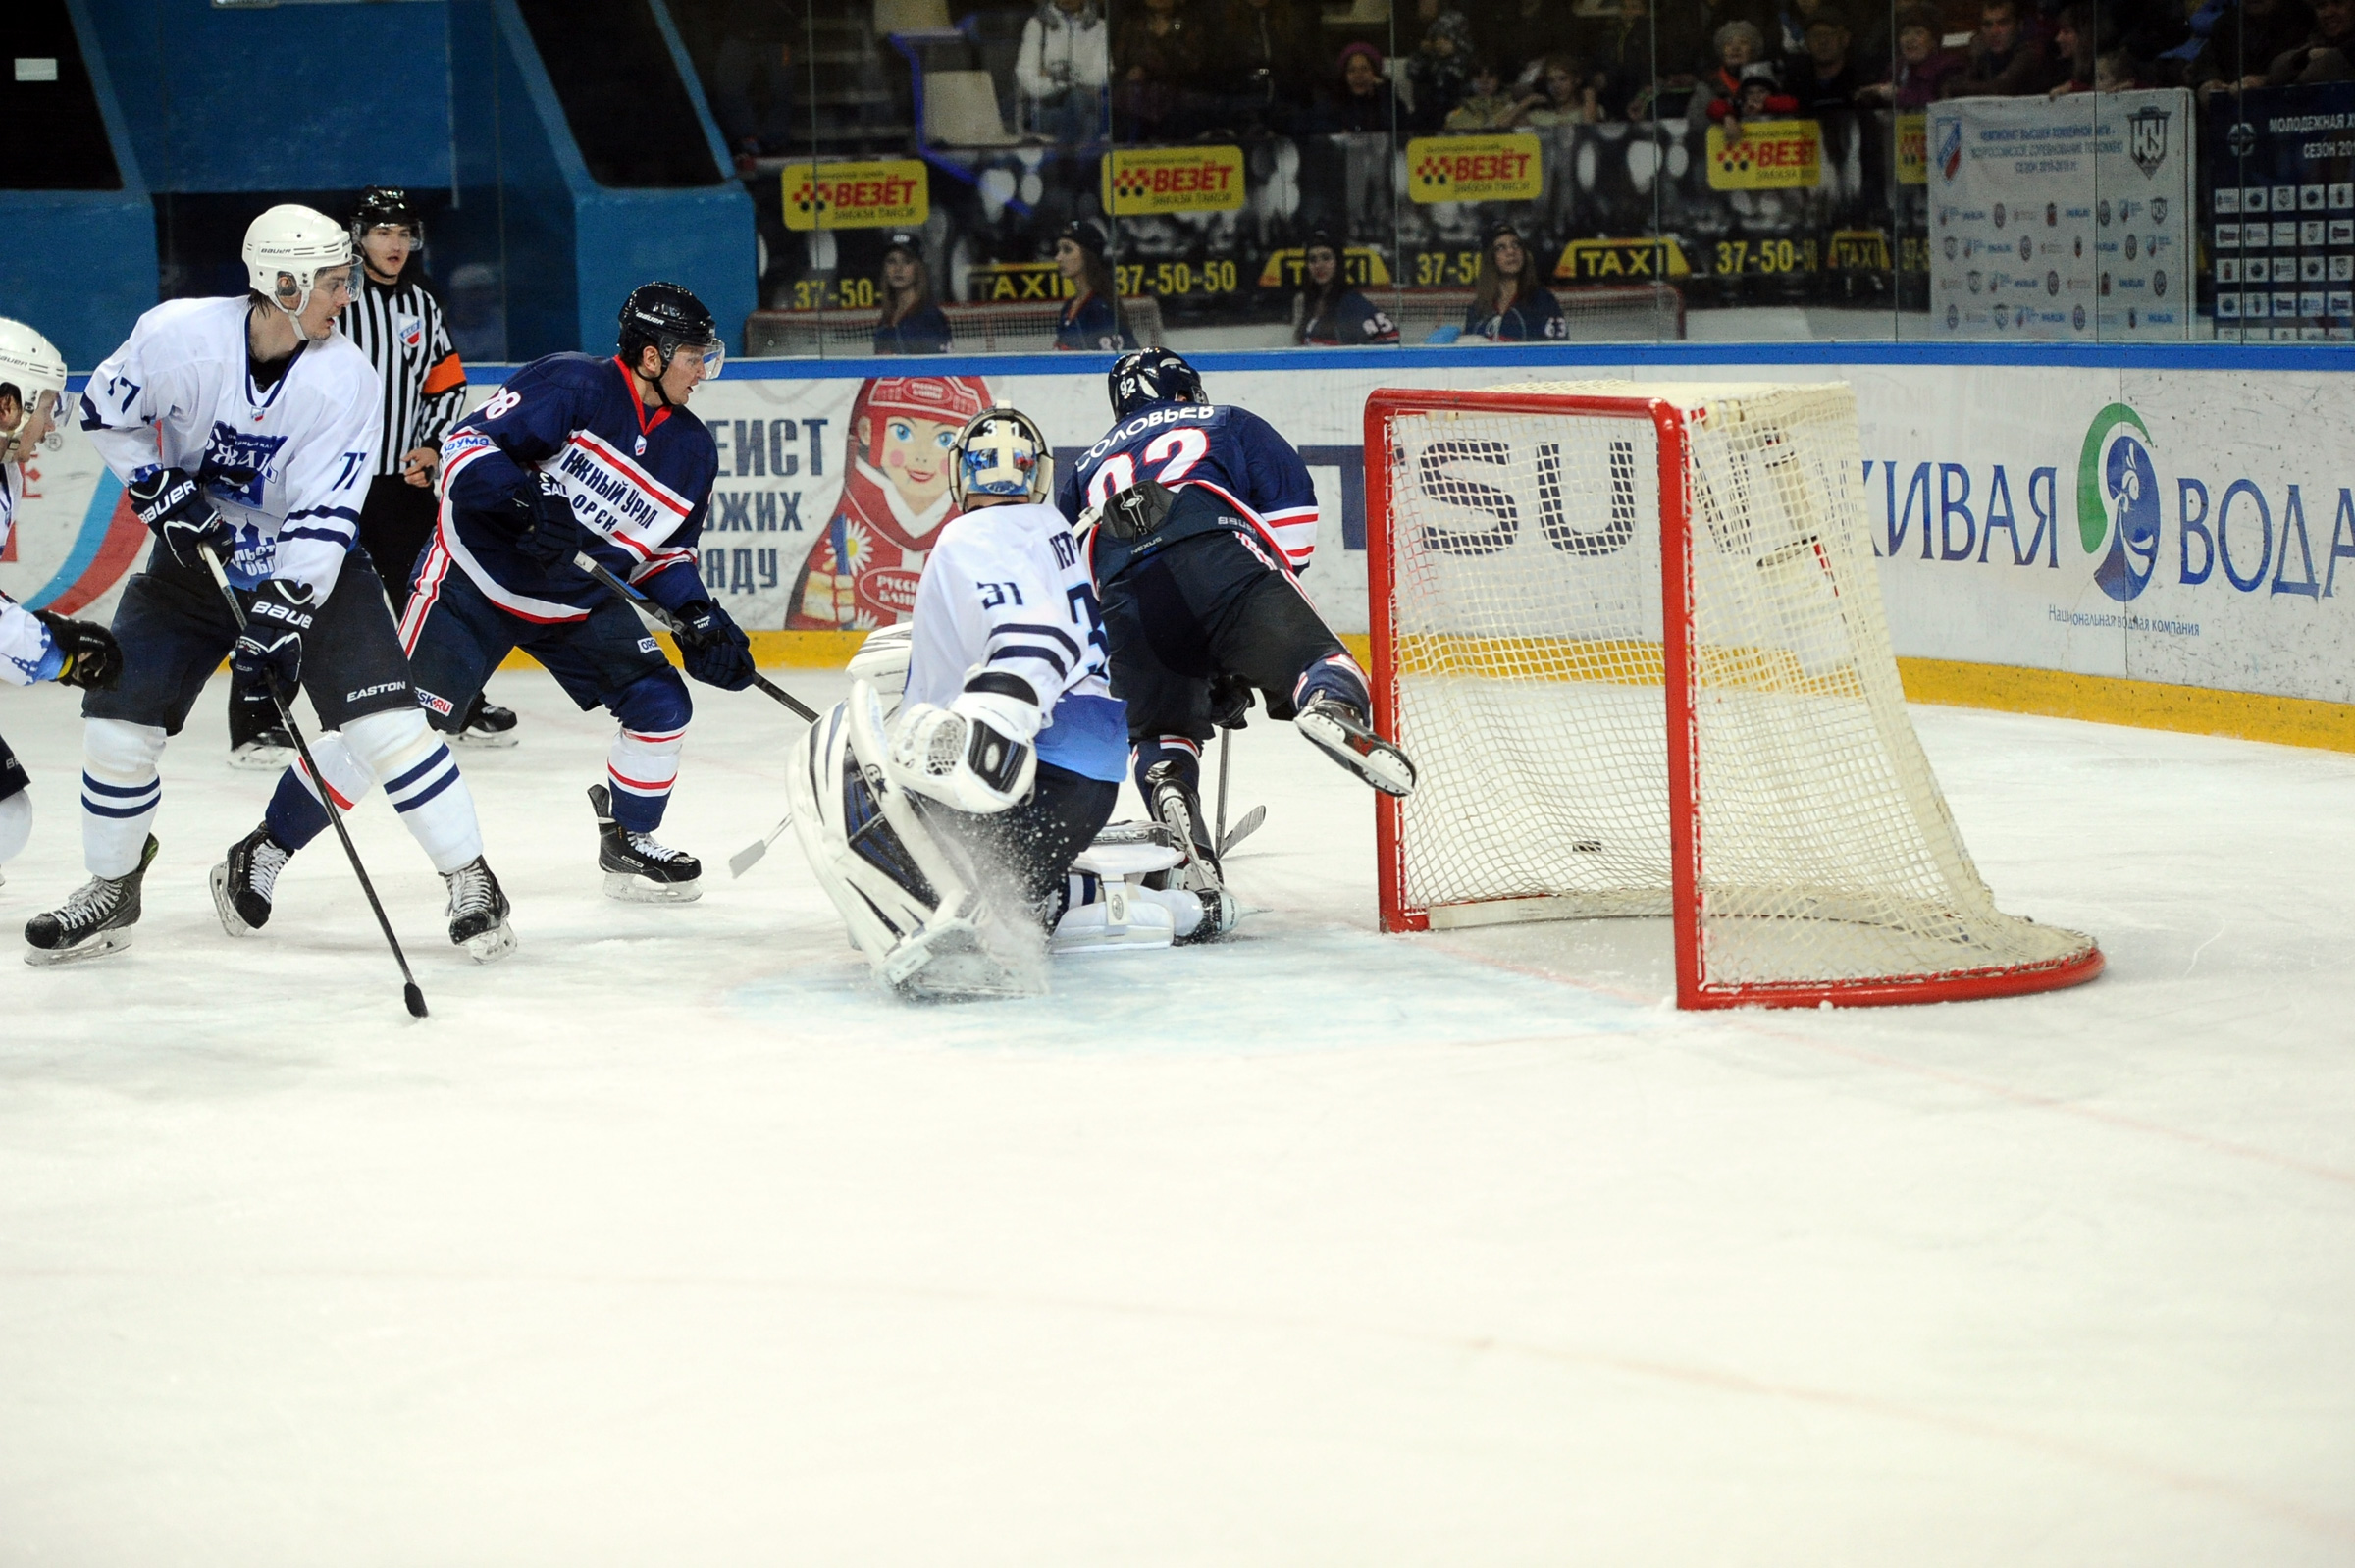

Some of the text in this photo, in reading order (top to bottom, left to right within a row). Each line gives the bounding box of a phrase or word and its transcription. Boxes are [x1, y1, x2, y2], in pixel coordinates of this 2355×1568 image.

[2269, 114, 2345, 133] МОЛОДЕЖНАЯ
[1455, 149, 1531, 181] ВЕЗЁТ
[2303, 143, 2336, 159] СЕЗОН
[835, 174, 917, 208] ВЕЗЁТ
[1154, 161, 1233, 192] ВЕЗЁТ
[1116, 260, 1237, 297] 37-50-50
[1286, 258, 1367, 285] TXI
[1580, 249, 1666, 277] TAXI
[0, 353, 28, 367] AUER
[1120, 377, 1138, 396] 92
[1074, 403, 1215, 473] СОЛОВЬЕВ
[332, 451, 368, 492] 77
[139, 479, 198, 524] BAUER
[572, 493, 619, 533] ОРСК
[620, 489, 658, 530] УРАЛ
[1130, 536, 1164, 556] NEXUS
[2176, 477, 2355, 602] ВОДА
[697, 549, 778, 595] ЯДУ
[251, 601, 314, 629] BAUE
[2049, 604, 2200, 638] Национальная водная компания
[346, 681, 407, 702] EASTON
